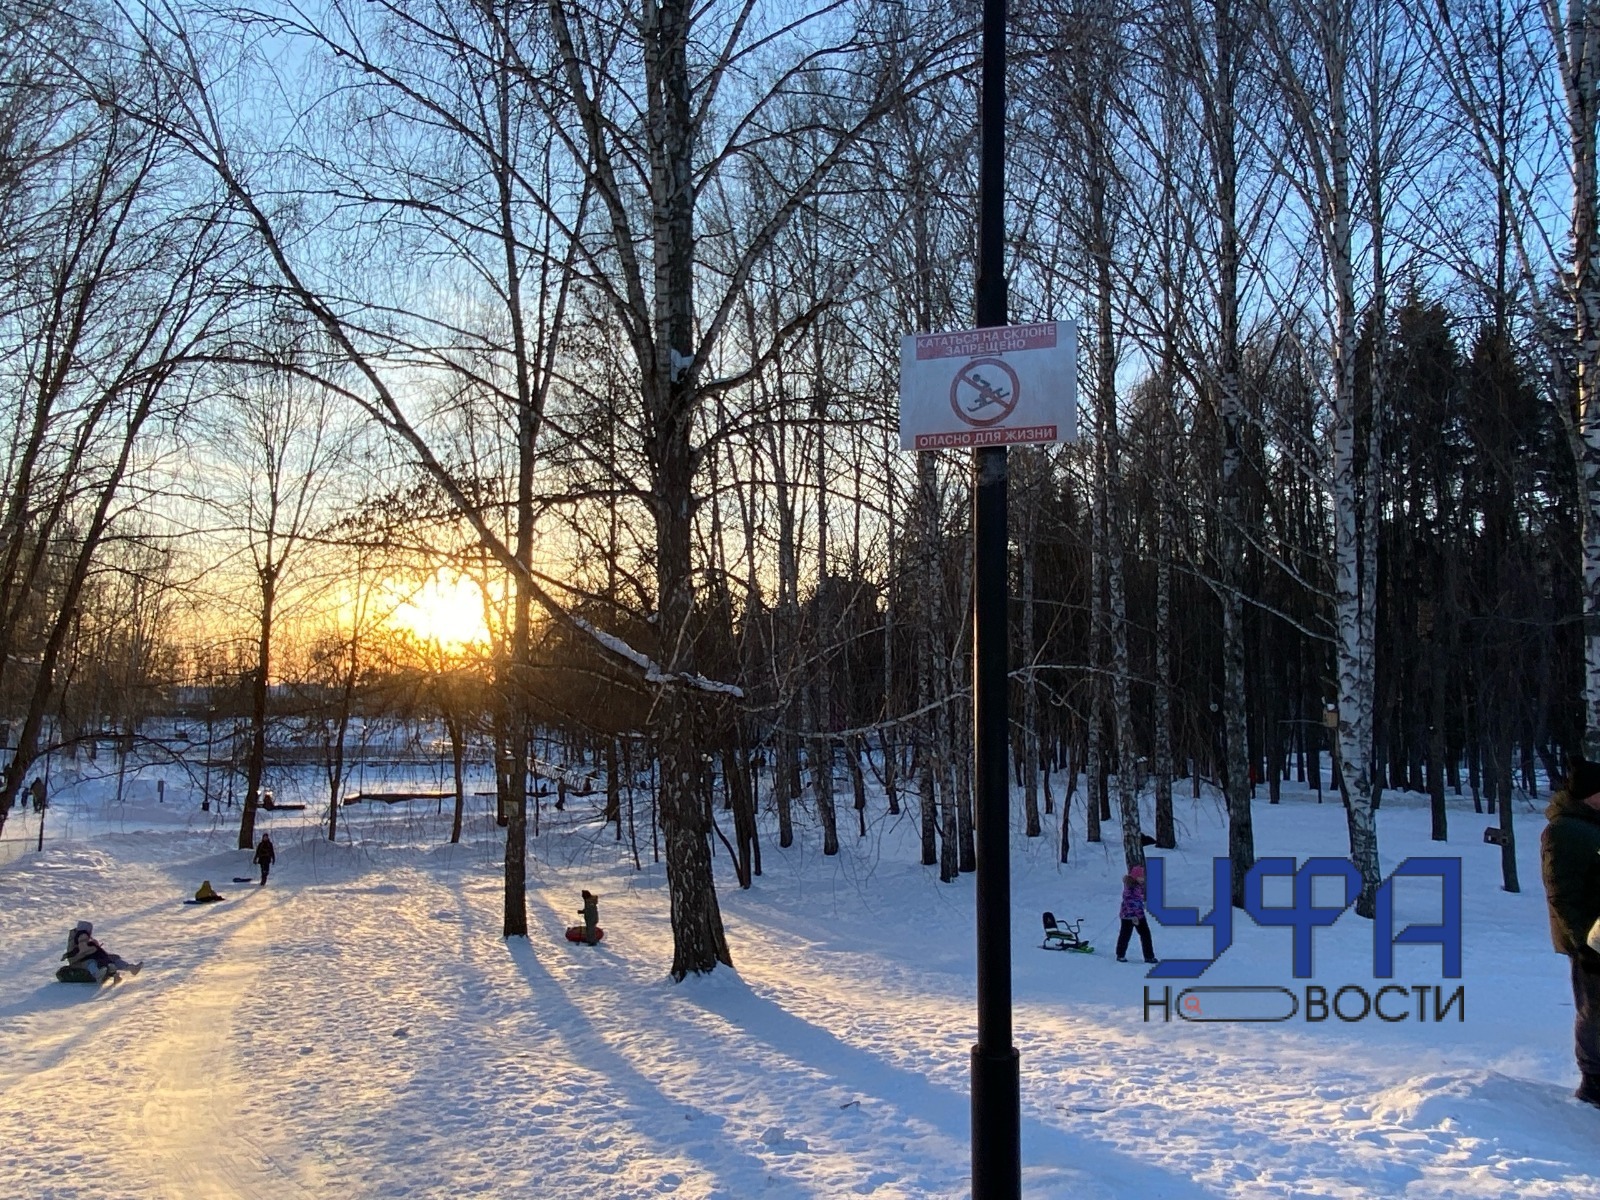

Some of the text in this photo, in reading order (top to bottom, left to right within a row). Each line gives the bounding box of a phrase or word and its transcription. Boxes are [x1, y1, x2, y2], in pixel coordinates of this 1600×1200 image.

[917, 326, 1055, 348] КАТАТЬСЯ НА СКЛОНЕ
[945, 340, 1025, 355] ЗАПРЕЩЕНО
[920, 428, 1053, 447] ОПАСНО ДЛЯ ЖИЗНИ
